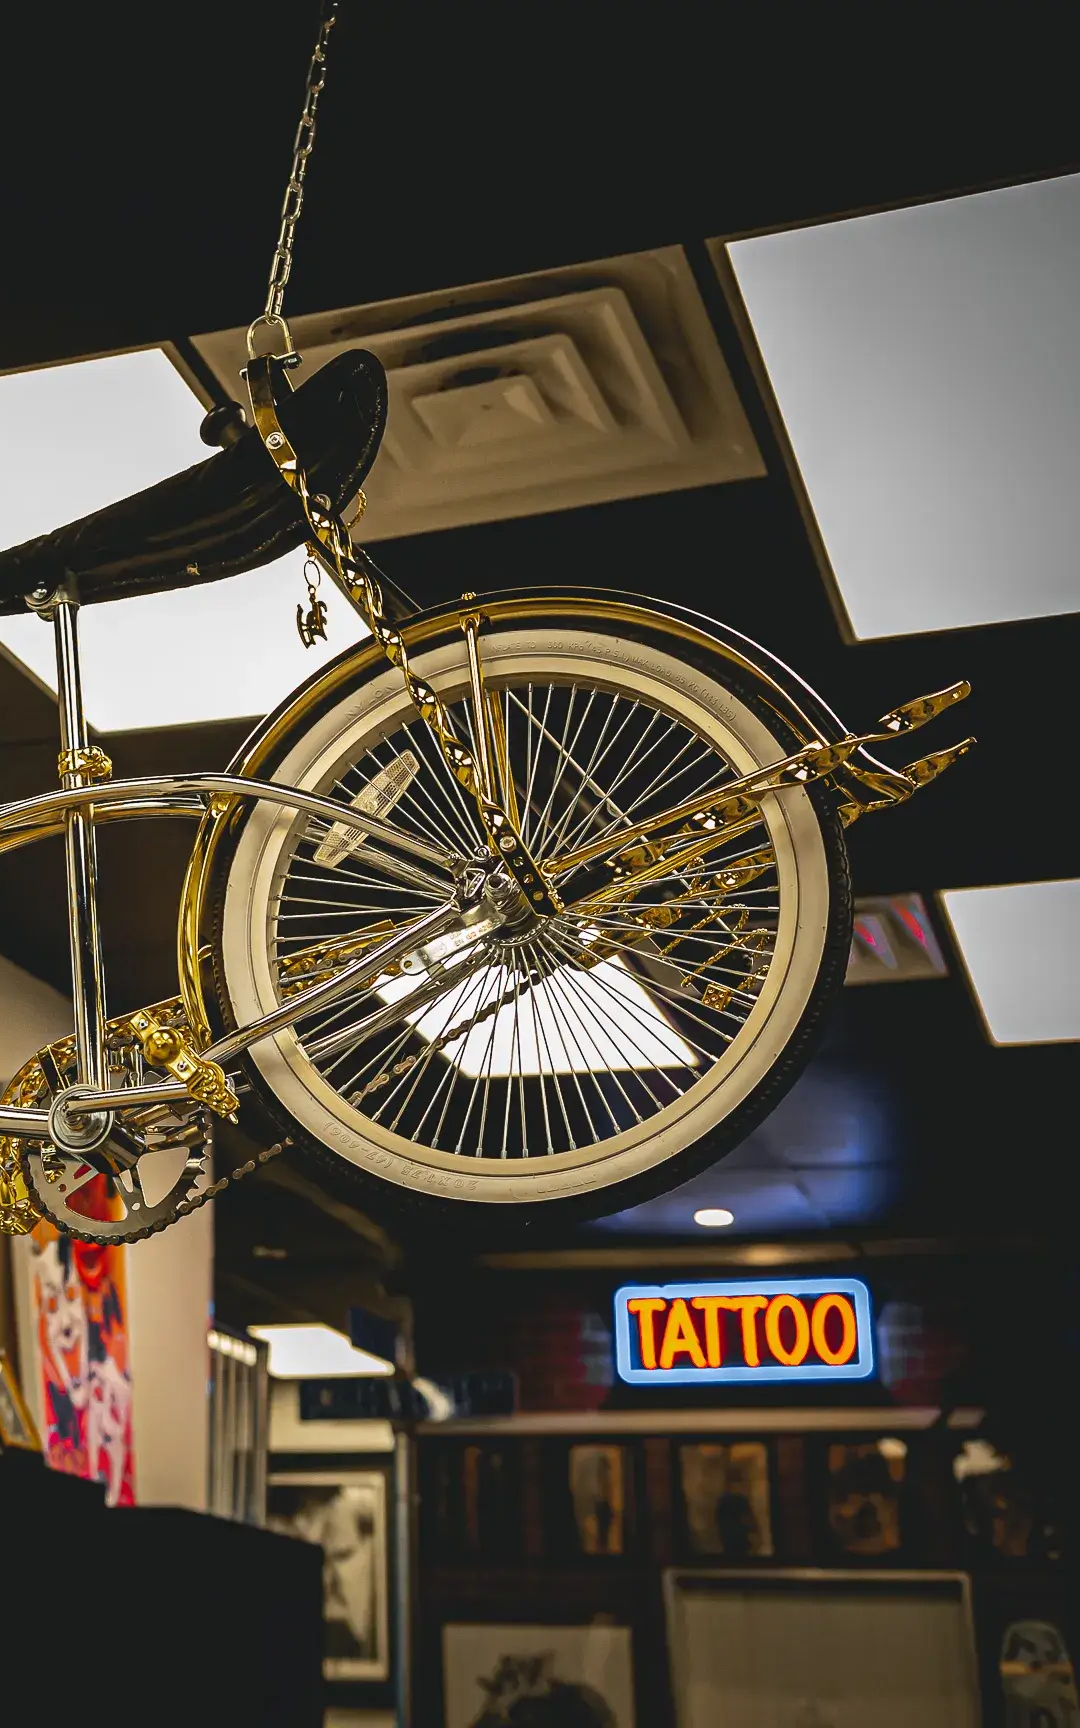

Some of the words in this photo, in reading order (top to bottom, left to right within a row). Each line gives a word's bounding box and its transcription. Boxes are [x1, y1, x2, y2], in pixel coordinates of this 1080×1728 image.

[547, 641, 563, 650] 300
[323, 1121, 395, 1170] (47-406)
[627, 1293, 857, 1370] TATTOO
